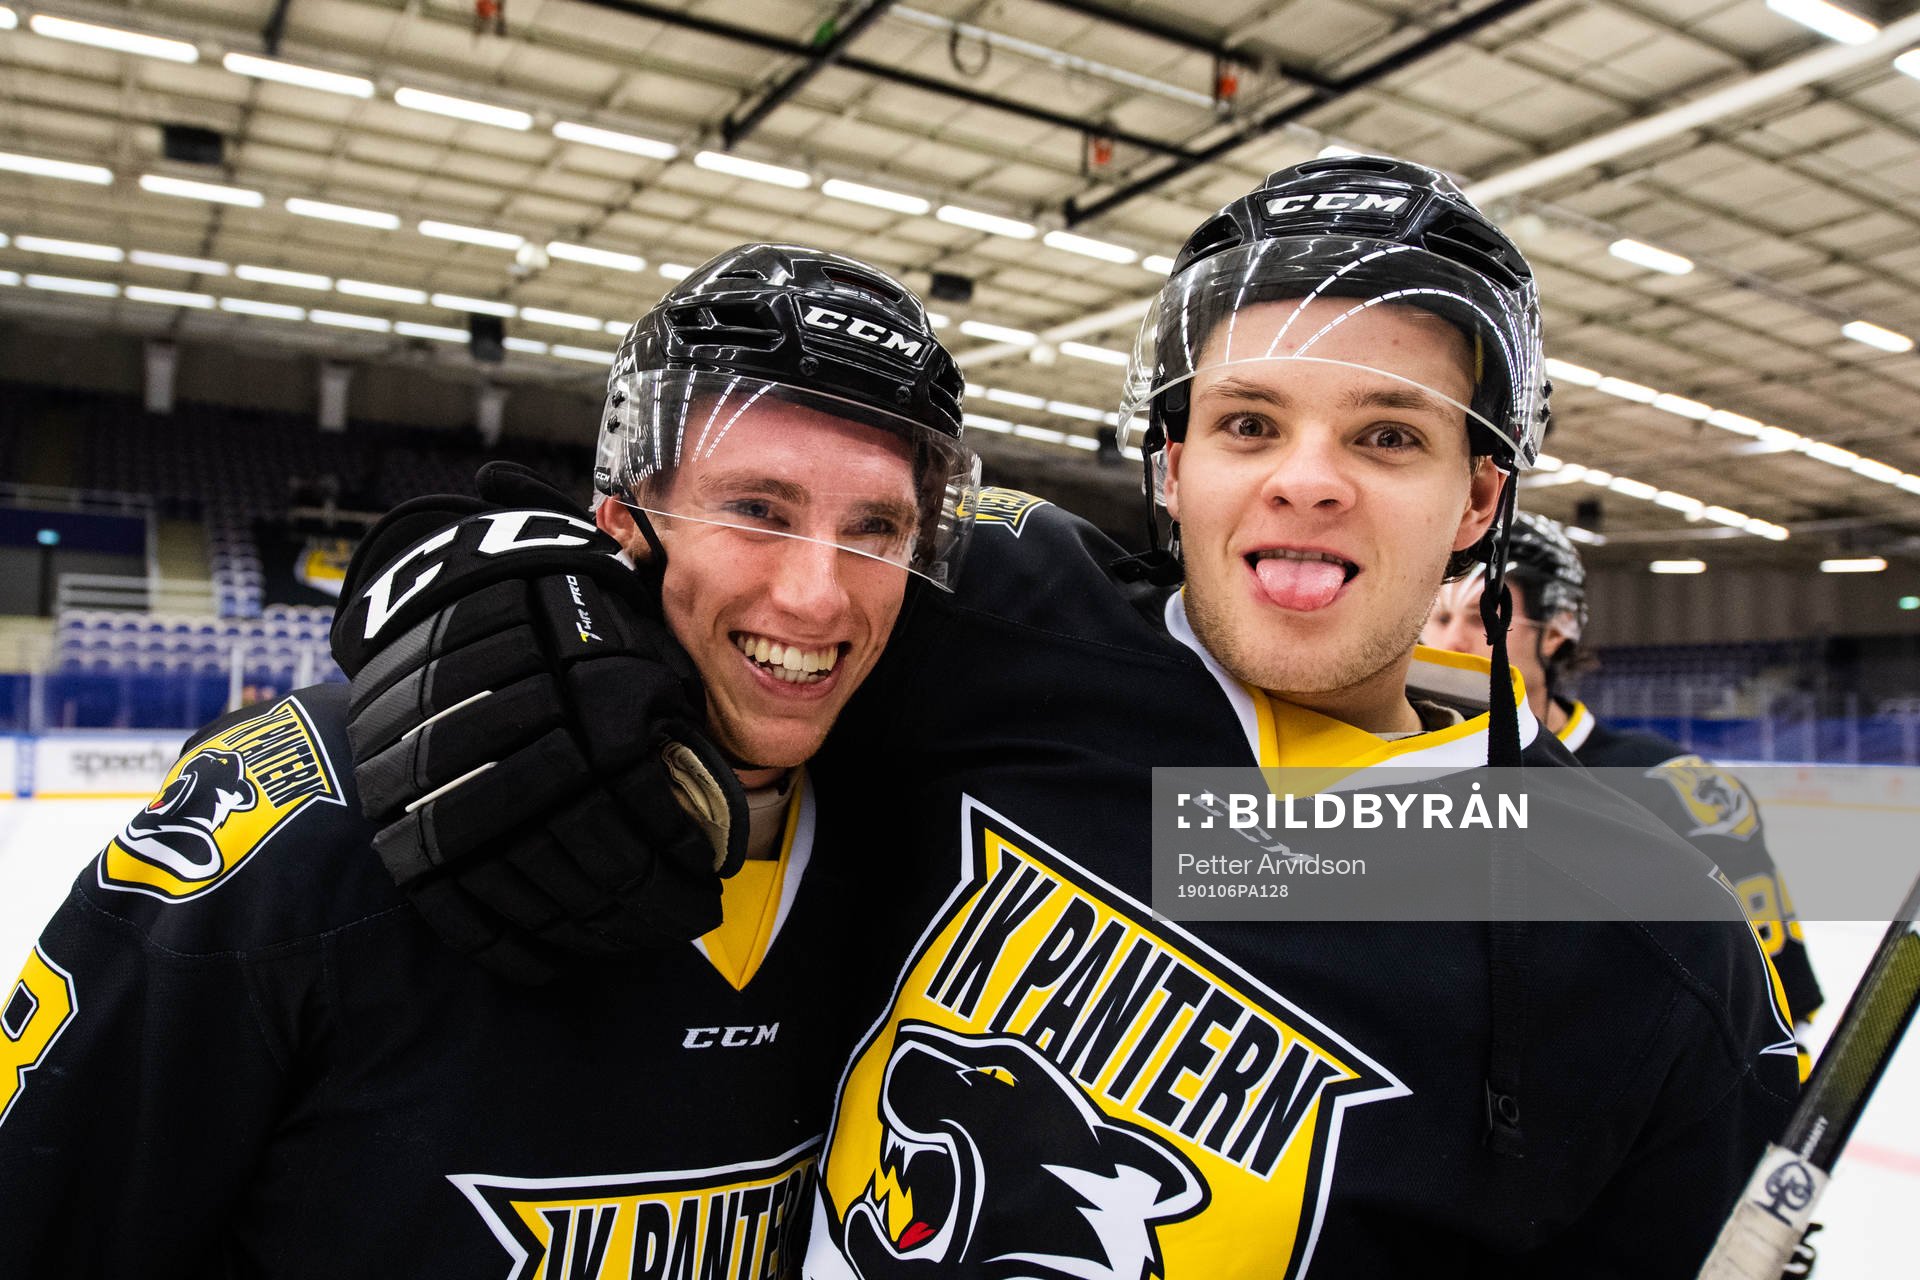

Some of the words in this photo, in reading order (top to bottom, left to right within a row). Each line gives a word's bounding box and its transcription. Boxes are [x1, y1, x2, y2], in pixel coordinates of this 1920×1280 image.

[1265, 192, 1408, 215] CCM
[803, 305, 923, 358] CCM
[565, 574, 586, 607] PRO
[230, 719, 329, 810] PANTERN
[922, 842, 1062, 1024] IK
[681, 1022, 780, 1049] CCM
[984, 892, 1346, 1183] PANTERN
[535, 1204, 621, 1280] IK
